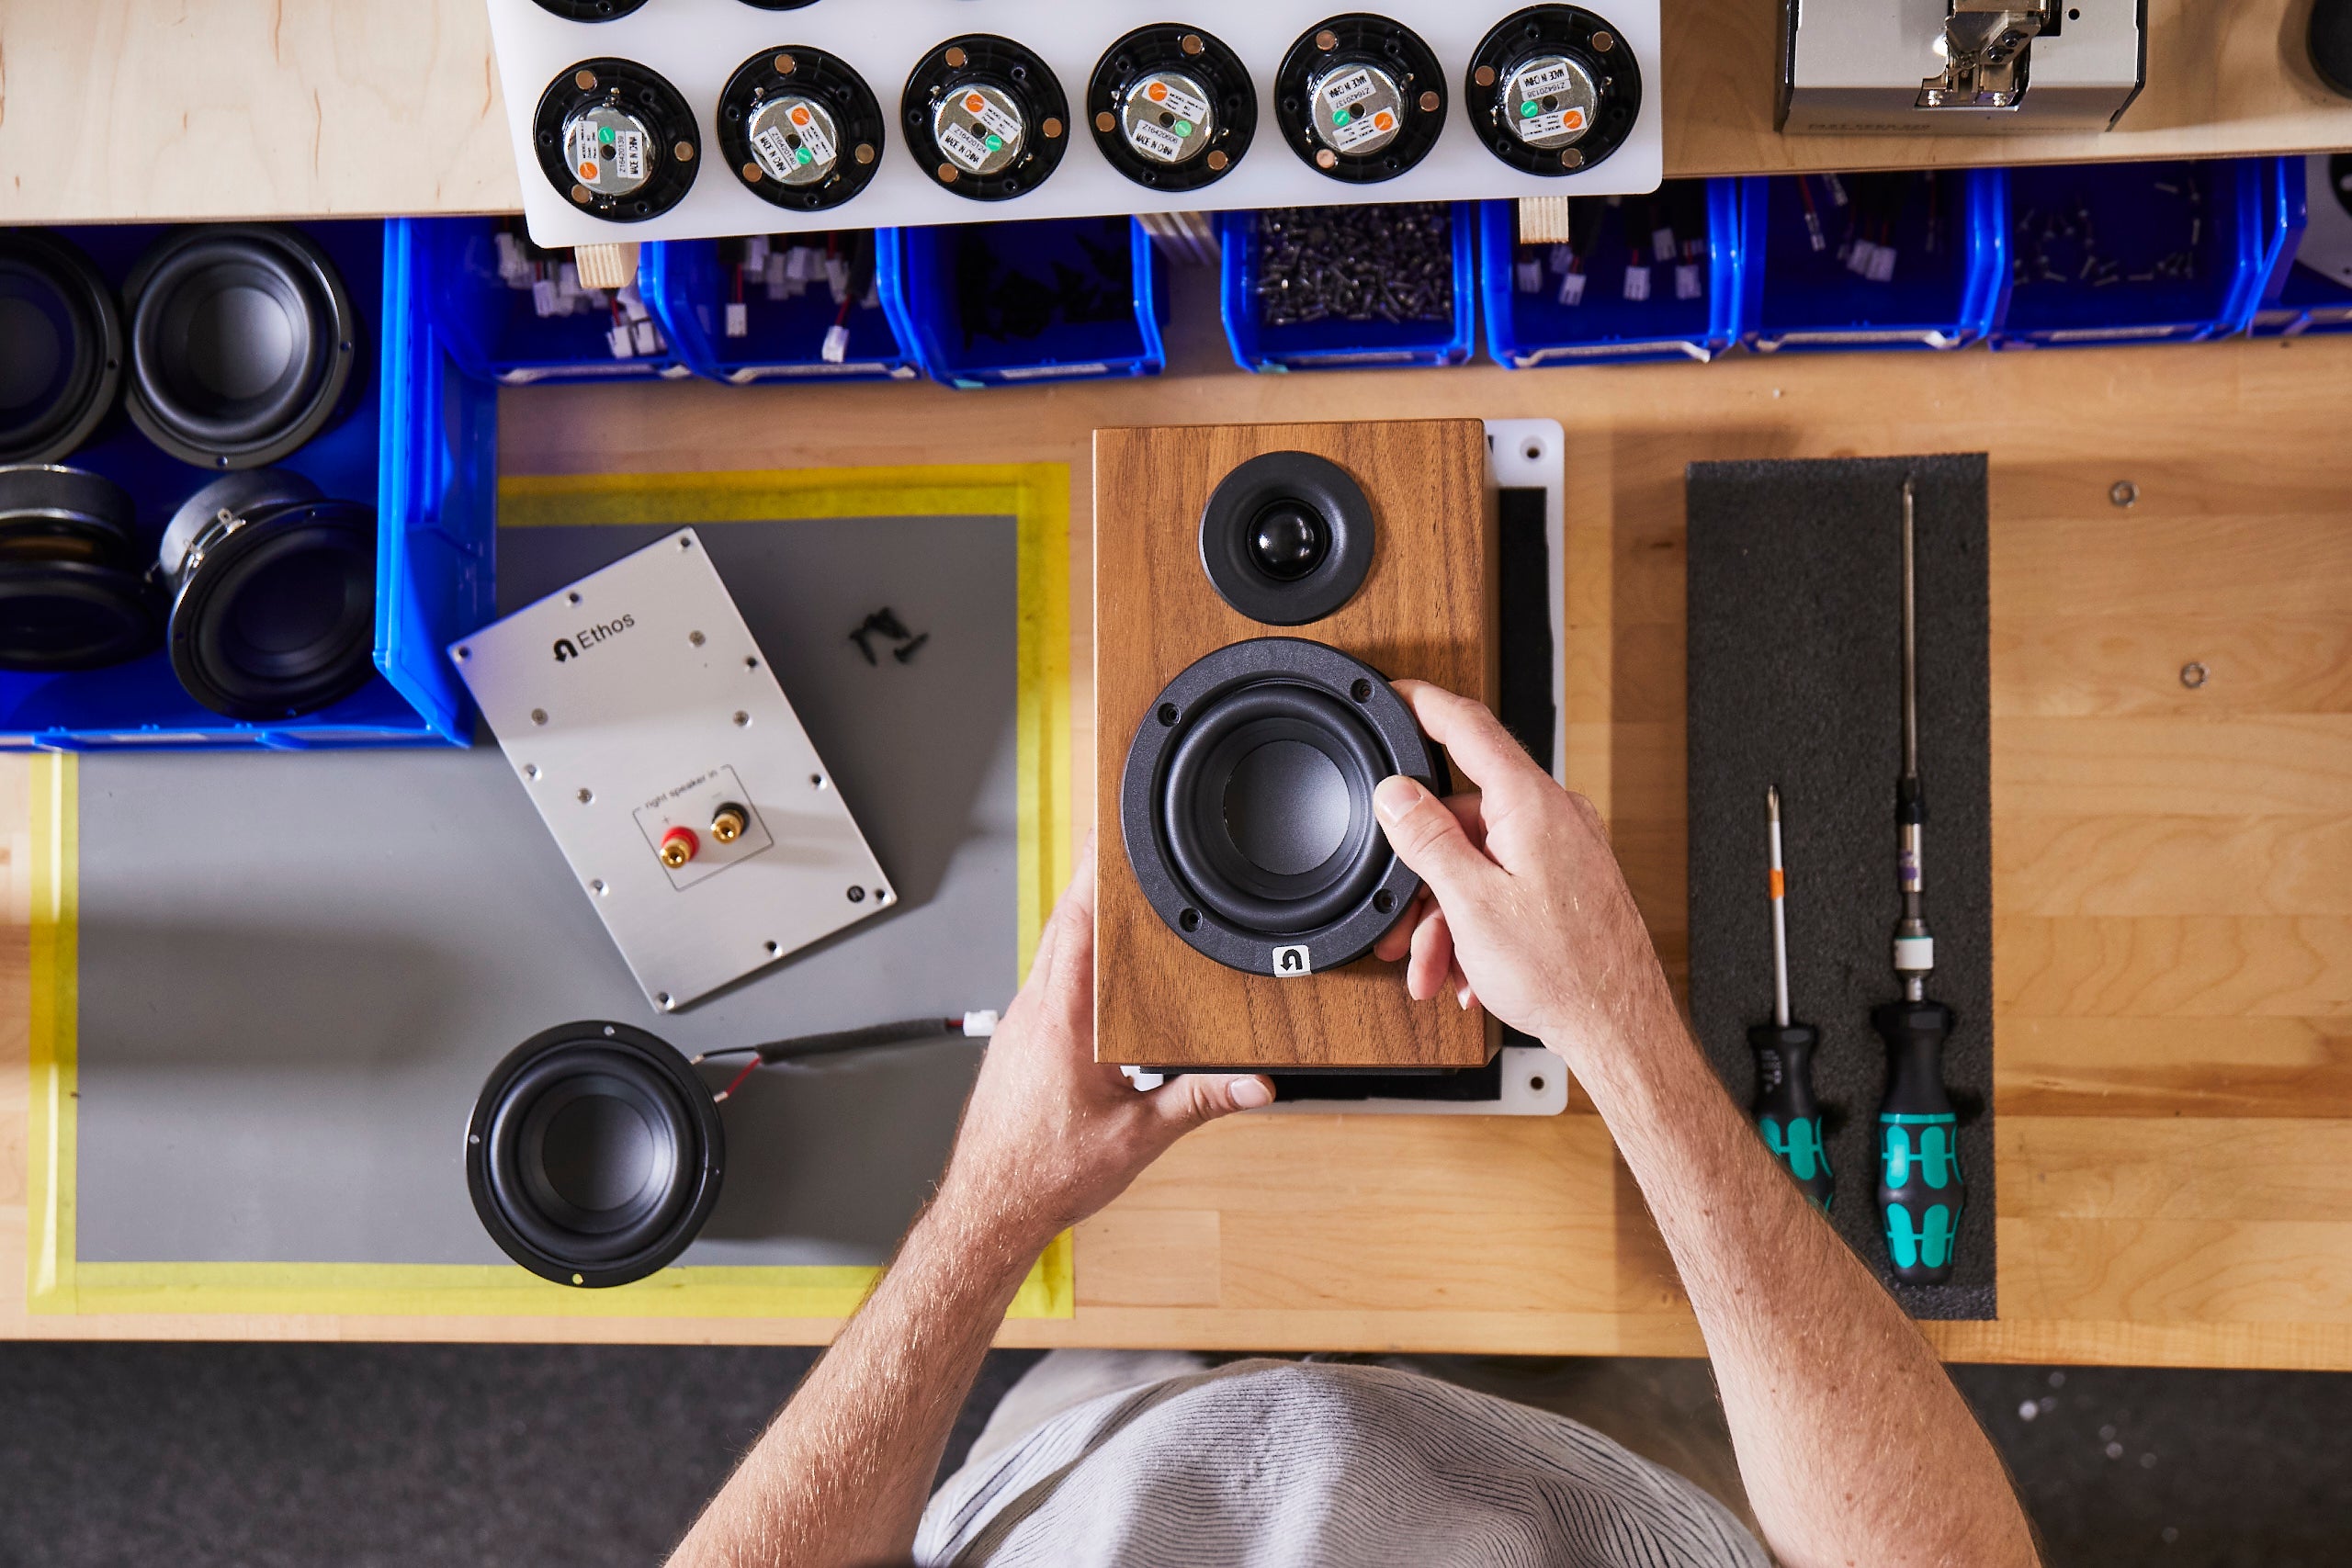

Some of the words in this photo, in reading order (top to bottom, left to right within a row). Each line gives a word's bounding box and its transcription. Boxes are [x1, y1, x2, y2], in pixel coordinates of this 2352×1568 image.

[1524, 75, 1540, 87] CHINA
[1541, 73, 1547, 83] IN
[1549, 69, 1565, 80] MADE
[1344, 82, 1351, 90] IN
[1351, 75, 1367, 88] MADE
[1329, 85, 1345, 98] CHINA
[945, 135, 960, 149] MADE
[957, 144, 967, 153] IN
[965, 149, 980, 164] CHINA
[1136, 133, 1150, 145] MADE
[1150, 141, 1159, 149] IN
[1158, 143, 1173, 155] CHINA
[760, 136, 772, 150] MADE
[774, 156, 786, 171] CHINA
[576, 614, 635, 649] Ethos
[645, 794, 668, 809] right
[669, 774, 707, 797] speaker
[708, 769, 718, 778] in
